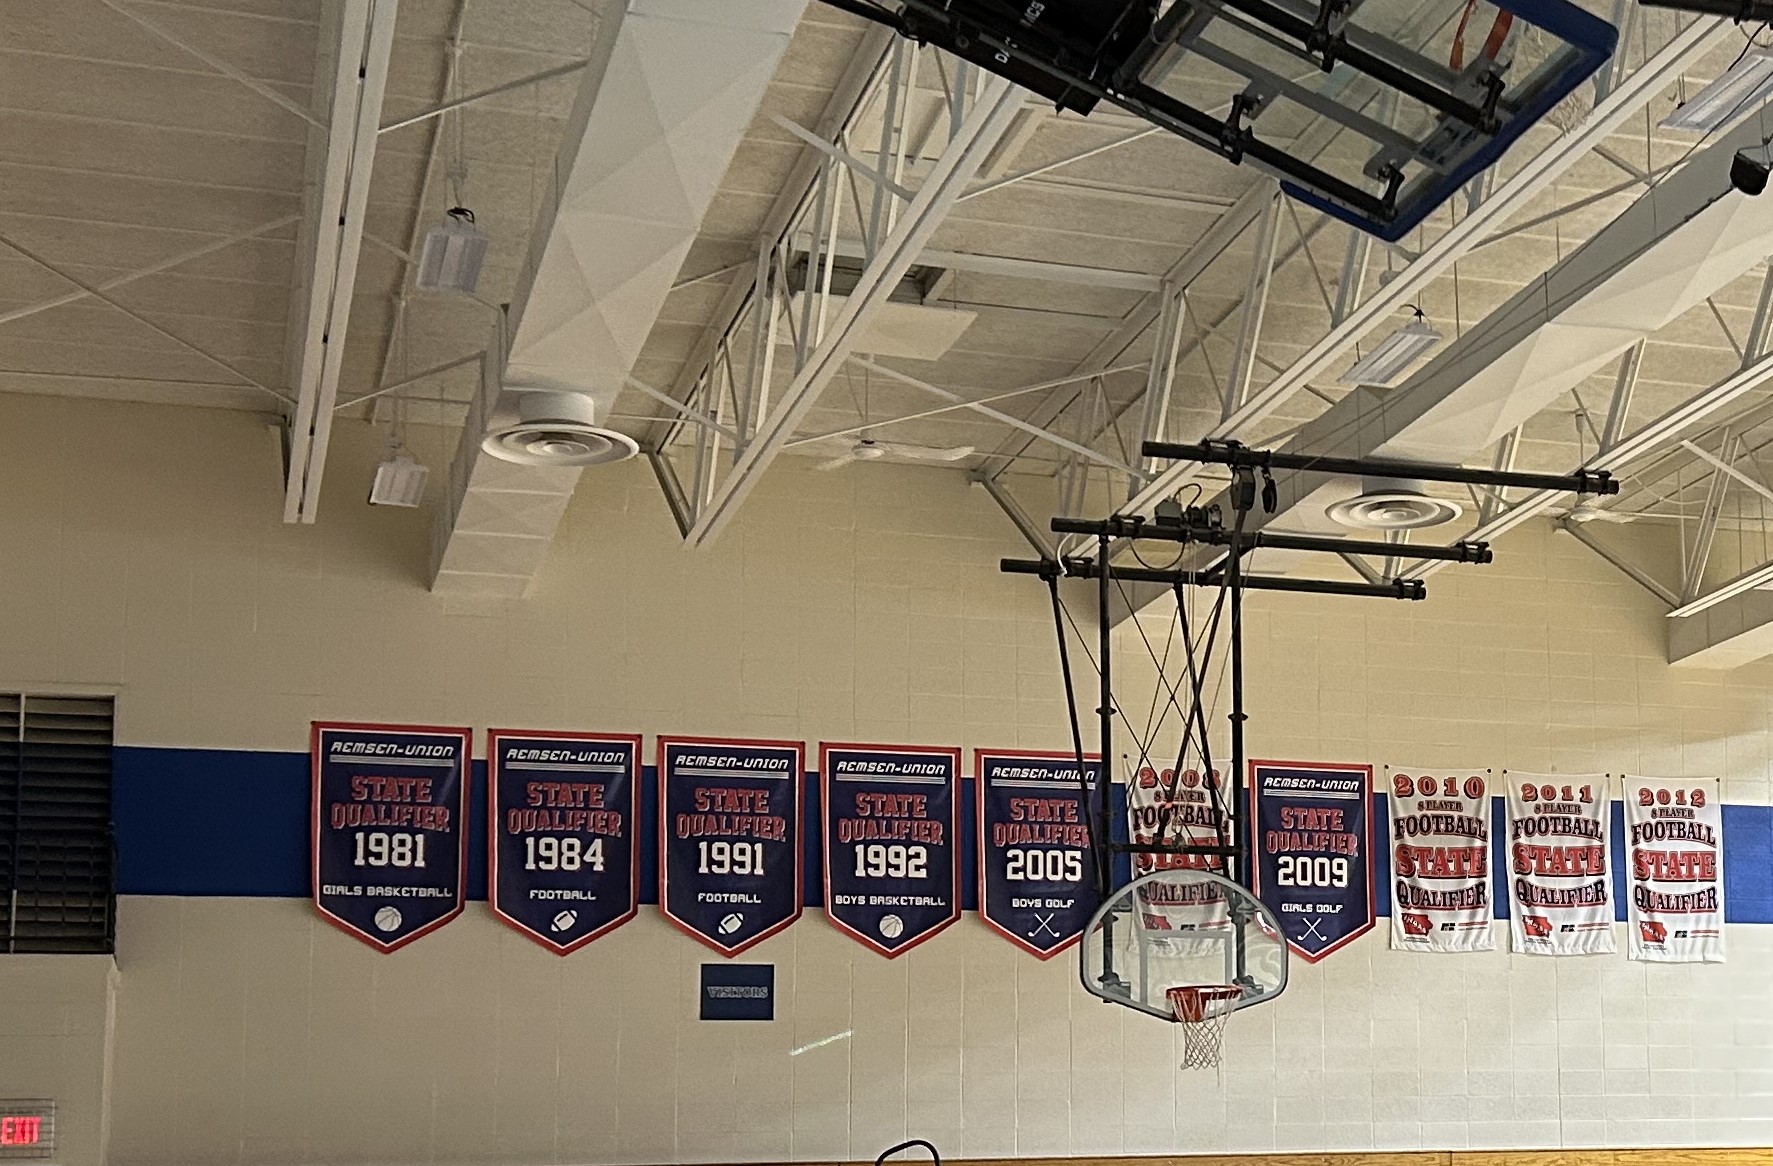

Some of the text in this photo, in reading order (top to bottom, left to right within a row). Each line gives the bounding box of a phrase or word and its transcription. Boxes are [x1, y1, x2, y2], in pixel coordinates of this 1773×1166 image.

[330, 741, 454, 757] REMSEN-UNION
[506, 748, 625, 763] REMSEN-UNION
[675, 755, 789, 770] REMSEN-UNION
[836, 761, 946, 775] REMSEN-UNION
[991, 767, 1096, 780] REMSEN-UNIN
[1139, 766, 1222, 789] 2008
[351, 775, 432, 803] STATE
[527, 782, 605, 808] STATE
[1264, 777, 1360, 791] REMSEN-UNION
[1393, 773, 1485, 799] 2010
[1521, 783, 1593, 803] 2011
[1638, 787, 1706, 808] 2012
[694, 787, 769, 814] STATE
[855, 792, 927, 818] STATE
[1010, 798, 1078, 823] STATE
[330, 803, 450, 833] QUALIFIER
[507, 808, 622, 838] QUALIFIER
[676, 813, 786, 843] QUALIFIER
[1280, 806, 1344, 832] STATE
[1393, 814, 1488, 843] FOOTBALL
[1512, 816, 1603, 843] FOOTBALL
[838, 818, 944, 846] QUALIFIER
[1266, 831, 1359, 858] QUALIFIER
[1631, 821, 1717, 849] FOOTBALL
[354, 832, 426, 868] 1981
[525, 836, 604, 872] 1984
[698, 841, 764, 876] 1991
[855, 844, 927, 879] 1992
[1395, 843, 1488, 879] STATE
[1512, 842, 1606, 877] STATE
[1006, 849, 1082, 882] 2005
[1277, 856, 1348, 888] 2009
[1632, 847, 1717, 882] STATE
[322, 884, 453, 897] GIRLS BASKETBALL
[529, 889, 596, 901] FOOTBALL
[697, 892, 761, 904] FOOTBALL
[835, 895, 946, 906] BOYS BASKETBALL
[1012, 898, 1075, 909] BOYS GOLF
[1396, 880, 1487, 910] QUALIFIER
[1515, 877, 1607, 908] QUALIFIER
[1633, 884, 1719, 914] QUALIFIER
[1281, 903, 1343, 913] GIRLS GOLF
[707, 986, 768, 998] VISITORS
[1, 1116, 42, 1145] EXIT
